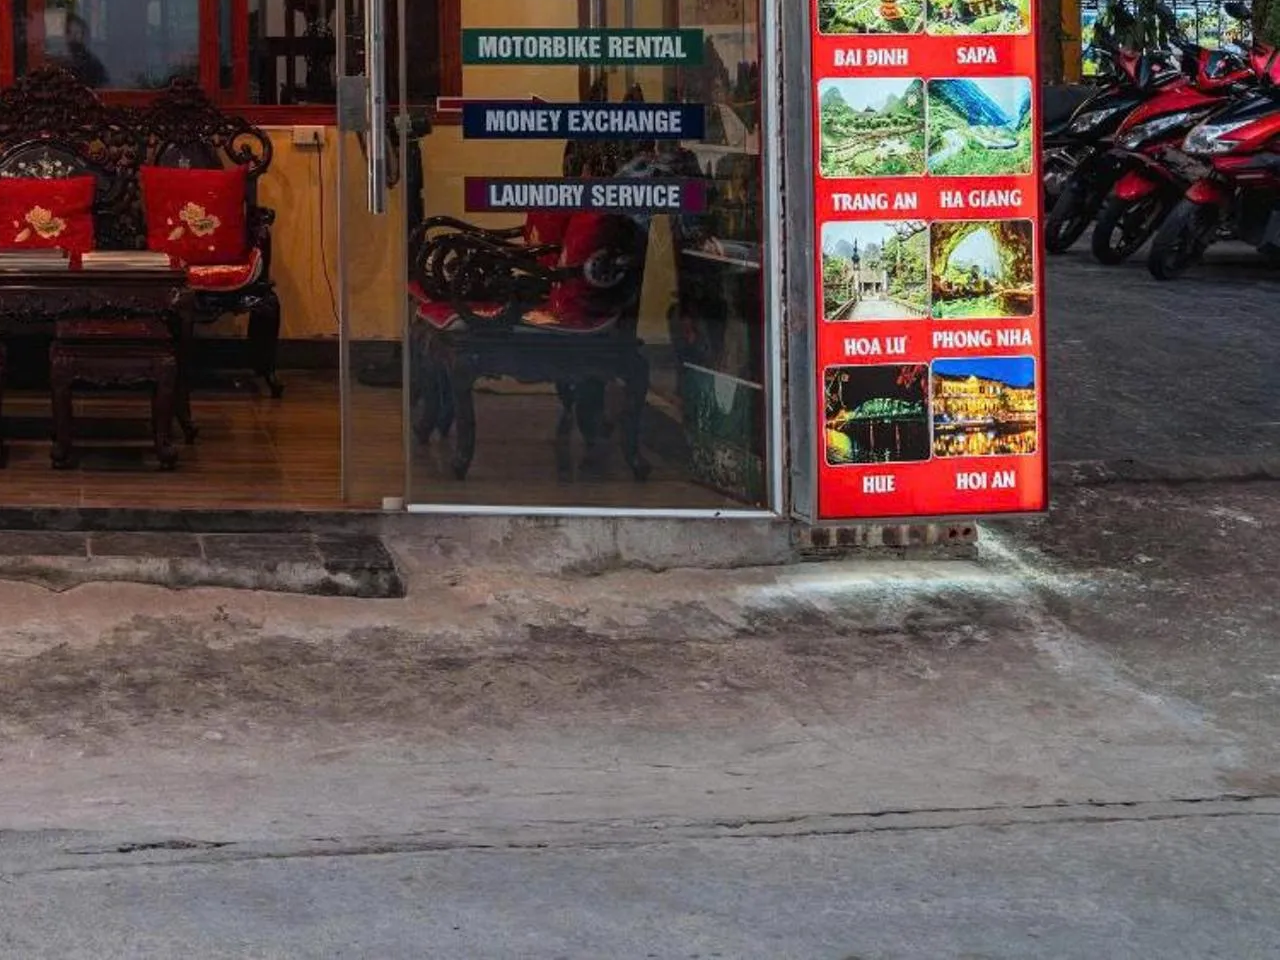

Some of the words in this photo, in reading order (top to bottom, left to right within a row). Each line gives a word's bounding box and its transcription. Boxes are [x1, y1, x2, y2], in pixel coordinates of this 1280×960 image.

[478, 36, 602, 58] MOTORBIKE
[608, 36, 687, 58] RENTAL
[956, 47, 997, 64] SAPA
[834, 49, 862, 65] BAI
[485, 109, 562, 132] MONEY
[568, 109, 682, 132] EXCHANGE
[489, 185, 584, 207] LAUNDRY
[591, 184, 680, 207] SERVICE
[832, 193, 889, 210] TRANG
[893, 193, 918, 209] AN
[940, 191, 964, 208] HA
[968, 190, 1022, 207] GIANG
[844, 337, 882, 356] HOA
[932, 330, 992, 349] PHONG
[996, 329, 1032, 347] NHA
[862, 475, 895, 493] HUE
[956, 472, 987, 489] HOI
[992, 470, 1016, 488] AN
